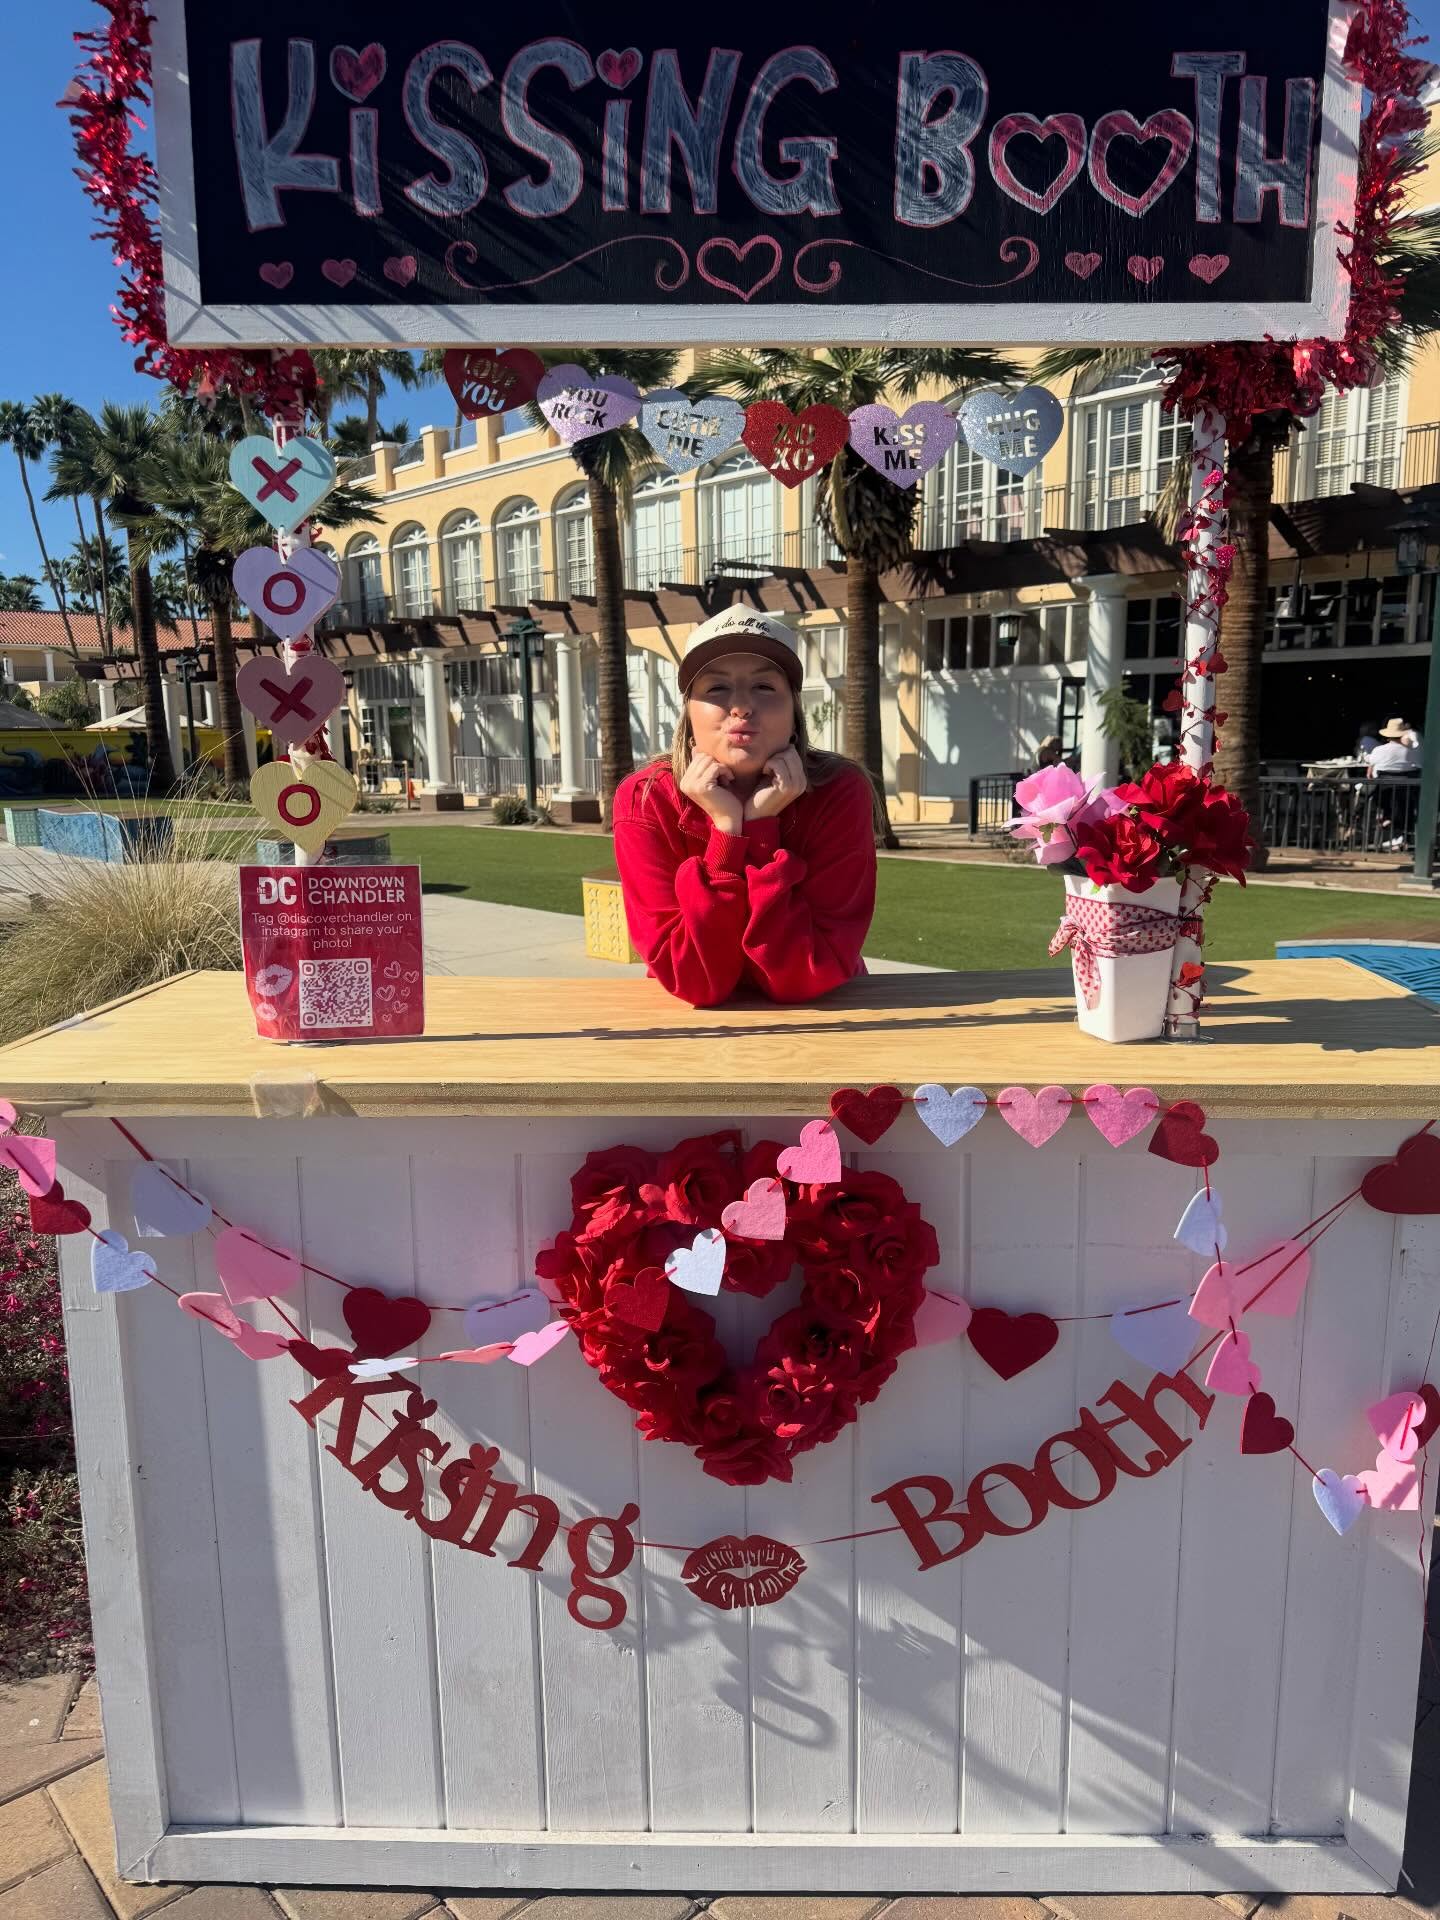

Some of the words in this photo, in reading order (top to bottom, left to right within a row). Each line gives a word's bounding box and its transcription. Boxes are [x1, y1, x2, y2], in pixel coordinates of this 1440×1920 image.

[460, 379, 506, 412] YOU
[564, 384, 609, 407] YOU
[551, 403, 609, 428] ROCK
[986, 408, 1041, 435] HUG
[667, 433, 705, 458] PIE
[771, 422, 816, 445] XO
[769, 446, 815, 471] XO
[884, 448, 922, 470] ME
[1000, 435, 1039, 460] ME
[251, 455, 303, 503] X
[262, 571, 306, 616] O
[737, 617, 757, 627] all
[259, 676, 317, 724] X
[277, 782, 322, 827] O
[308, 876, 405, 890] DOWNTOWN
[308, 889, 406, 905] CHANDLER
[252, 913, 274, 926] Tag
[277, 912, 394, 925] @discoverchandler
[324, 926, 336, 936] to
[340, 925, 373, 935] share
[377, 925, 403, 936] your
[313, 938, 353, 950] photo!
[289, 1372, 641, 1631] Kissing
[871, 1369, 1216, 1572] Booth
